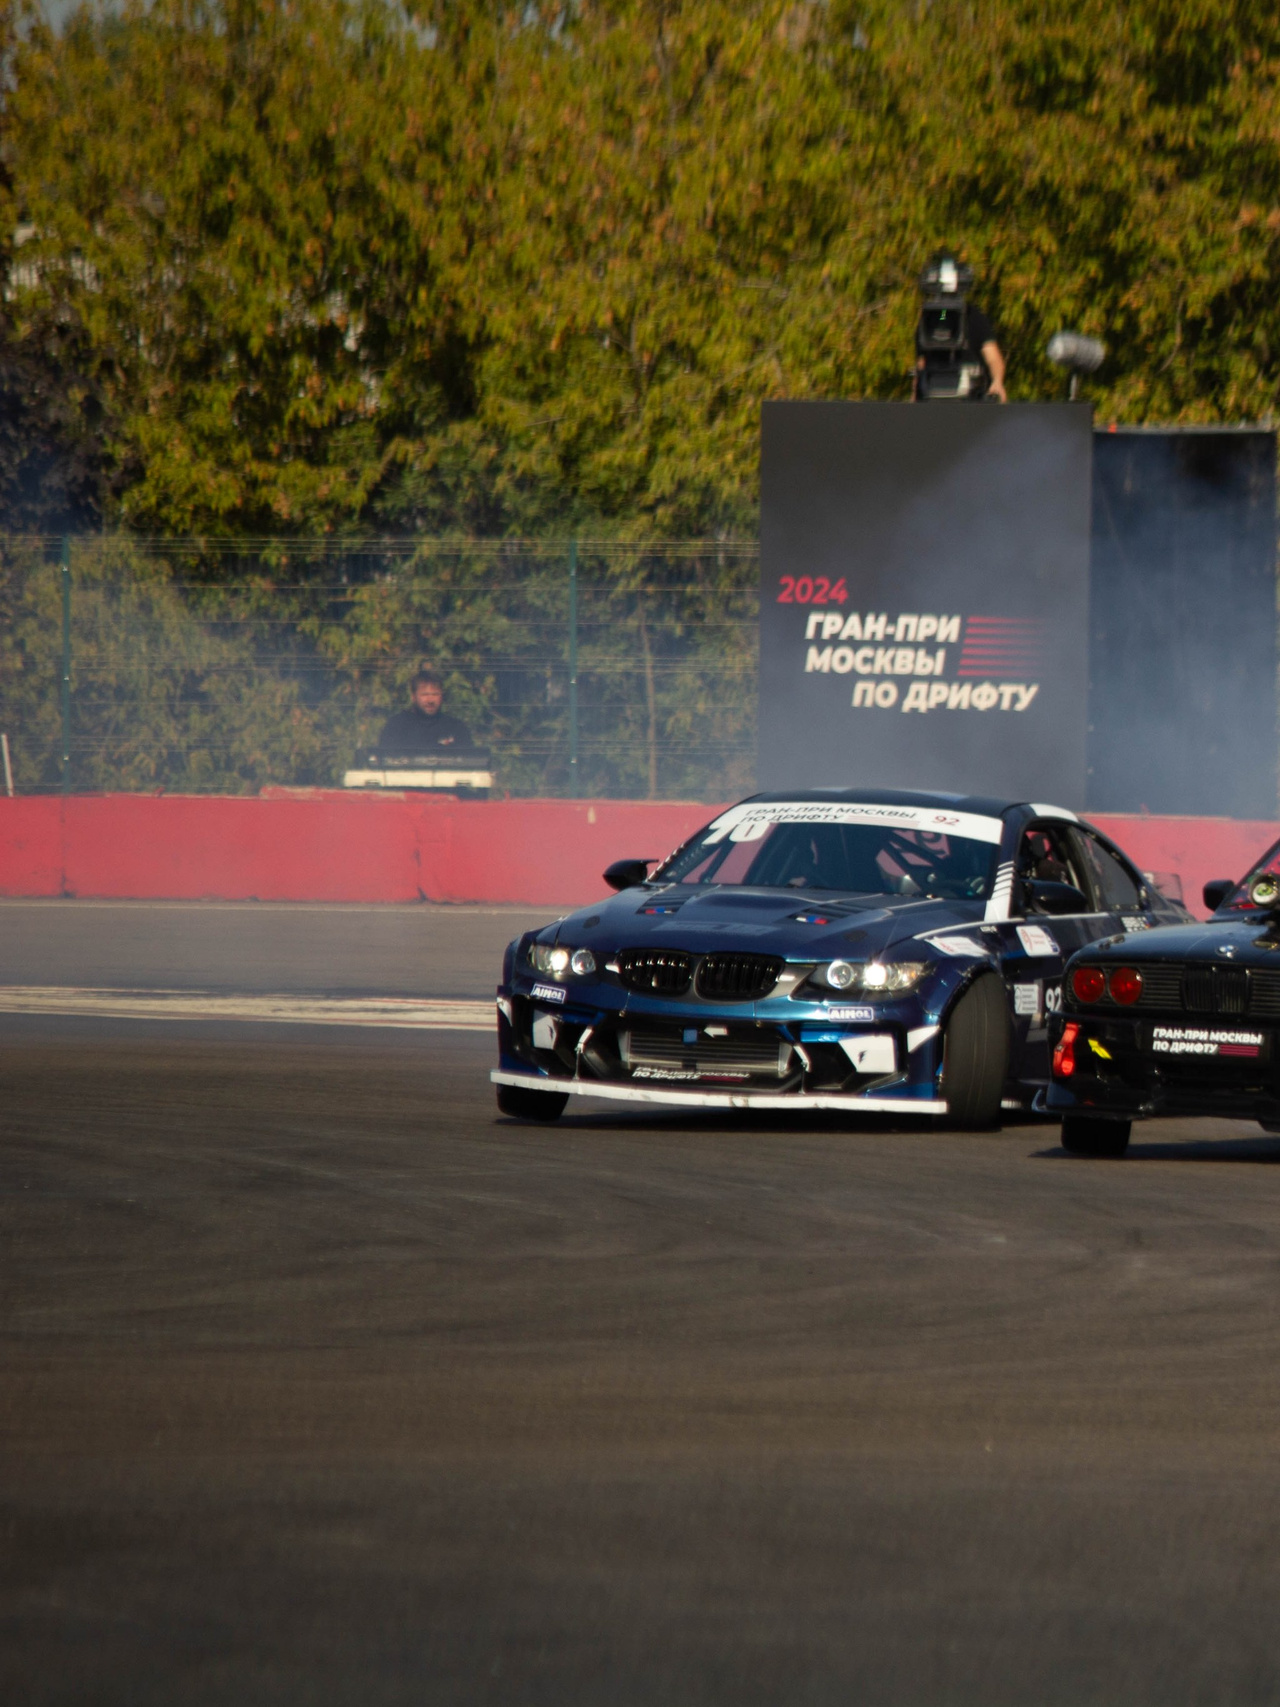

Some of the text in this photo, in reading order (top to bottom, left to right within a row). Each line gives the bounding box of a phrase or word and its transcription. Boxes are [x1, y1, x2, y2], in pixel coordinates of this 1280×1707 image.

[776, 574, 849, 605] 2024
[804, 610, 961, 643] ГРАН-ПРИ
[804, 645, 946, 676] МОСКВЫ
[851, 680, 1039, 713] ПО ДРИФТУ
[740, 813, 844, 823] ПО ДРИФТУ
[746, 805, 917, 820] ГРАН-ПРИ МОСКВЫ
[931, 814, 961, 827] 92
[830, 1008, 871, 1020] AIMOL
[1152, 1027, 1262, 1044] ГРАН-ПРИ МОСКВЫ
[1152, 1040, 1218, 1054] ПО ДРИФТУ
